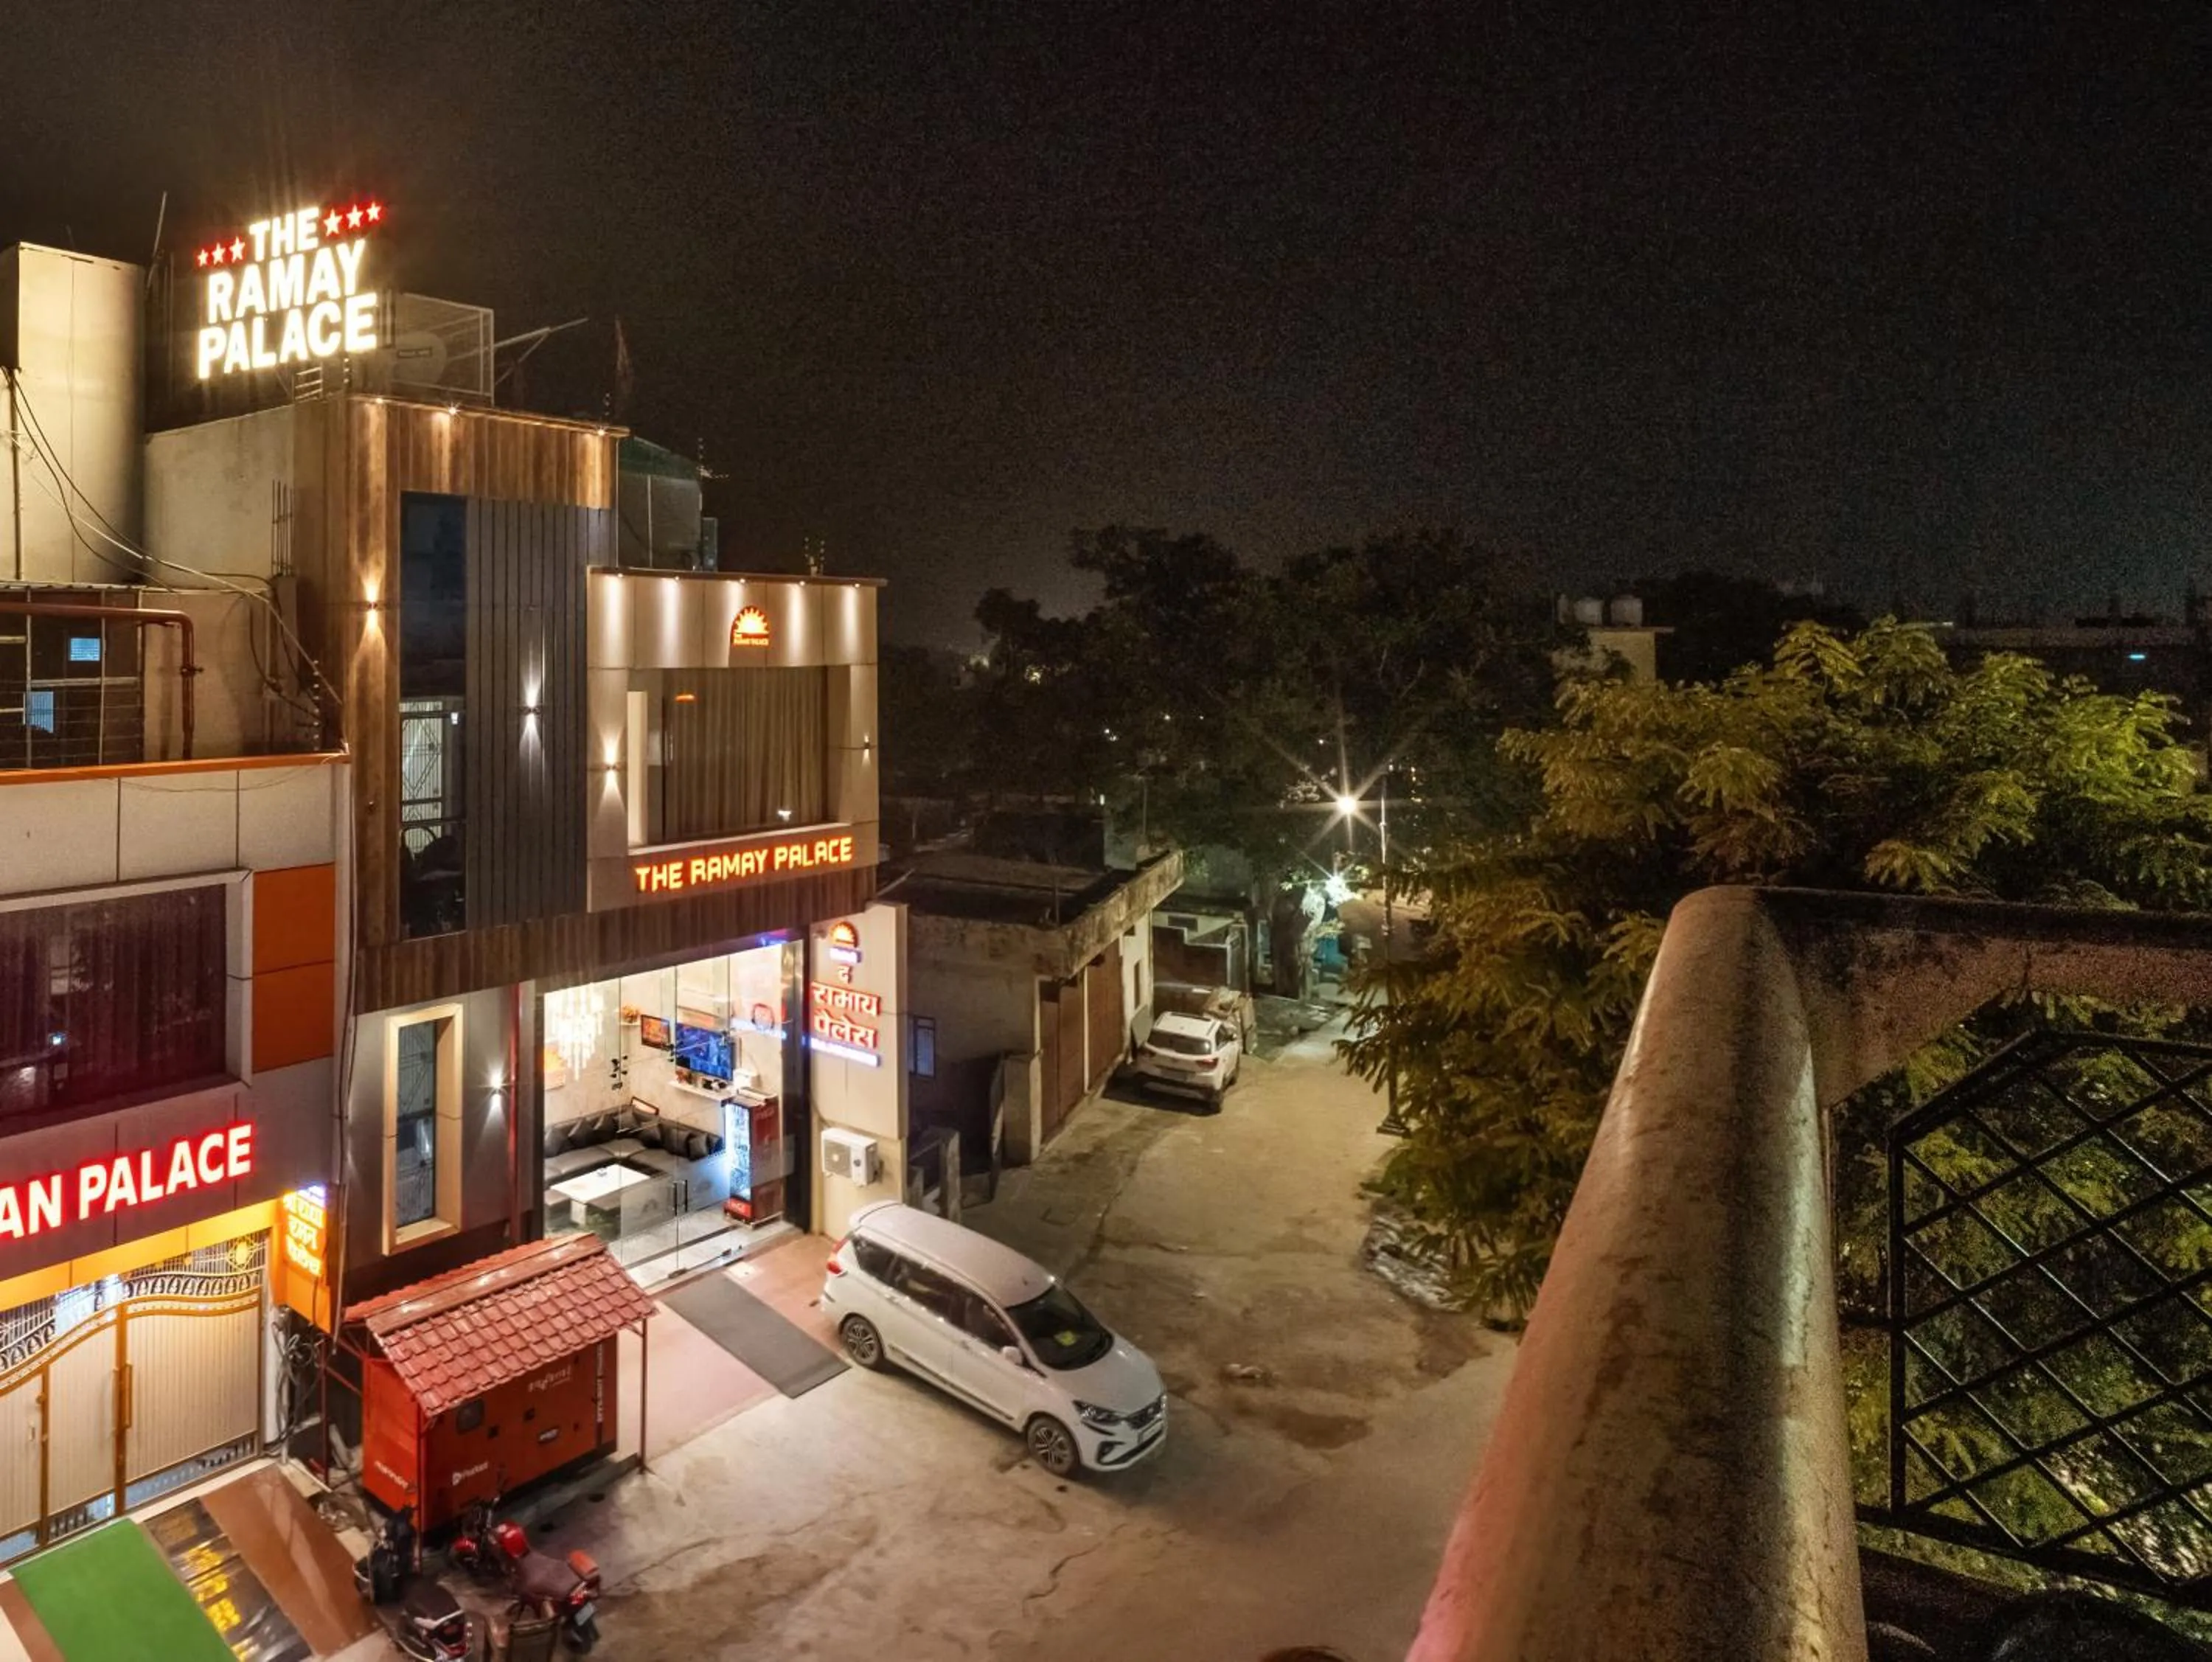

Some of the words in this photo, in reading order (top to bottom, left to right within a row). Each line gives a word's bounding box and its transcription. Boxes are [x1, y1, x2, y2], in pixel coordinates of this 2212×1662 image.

[249, 206, 320, 262] THE
[208, 238, 366, 324] RAMAY
[198, 292, 378, 379] PALACE
[635, 861, 684, 892] THE
[690, 849, 768, 885] RAMAY
[774, 837, 852, 870] PALACE
[838, 964, 852, 984] द
[78, 1124, 252, 1220] PALACE
